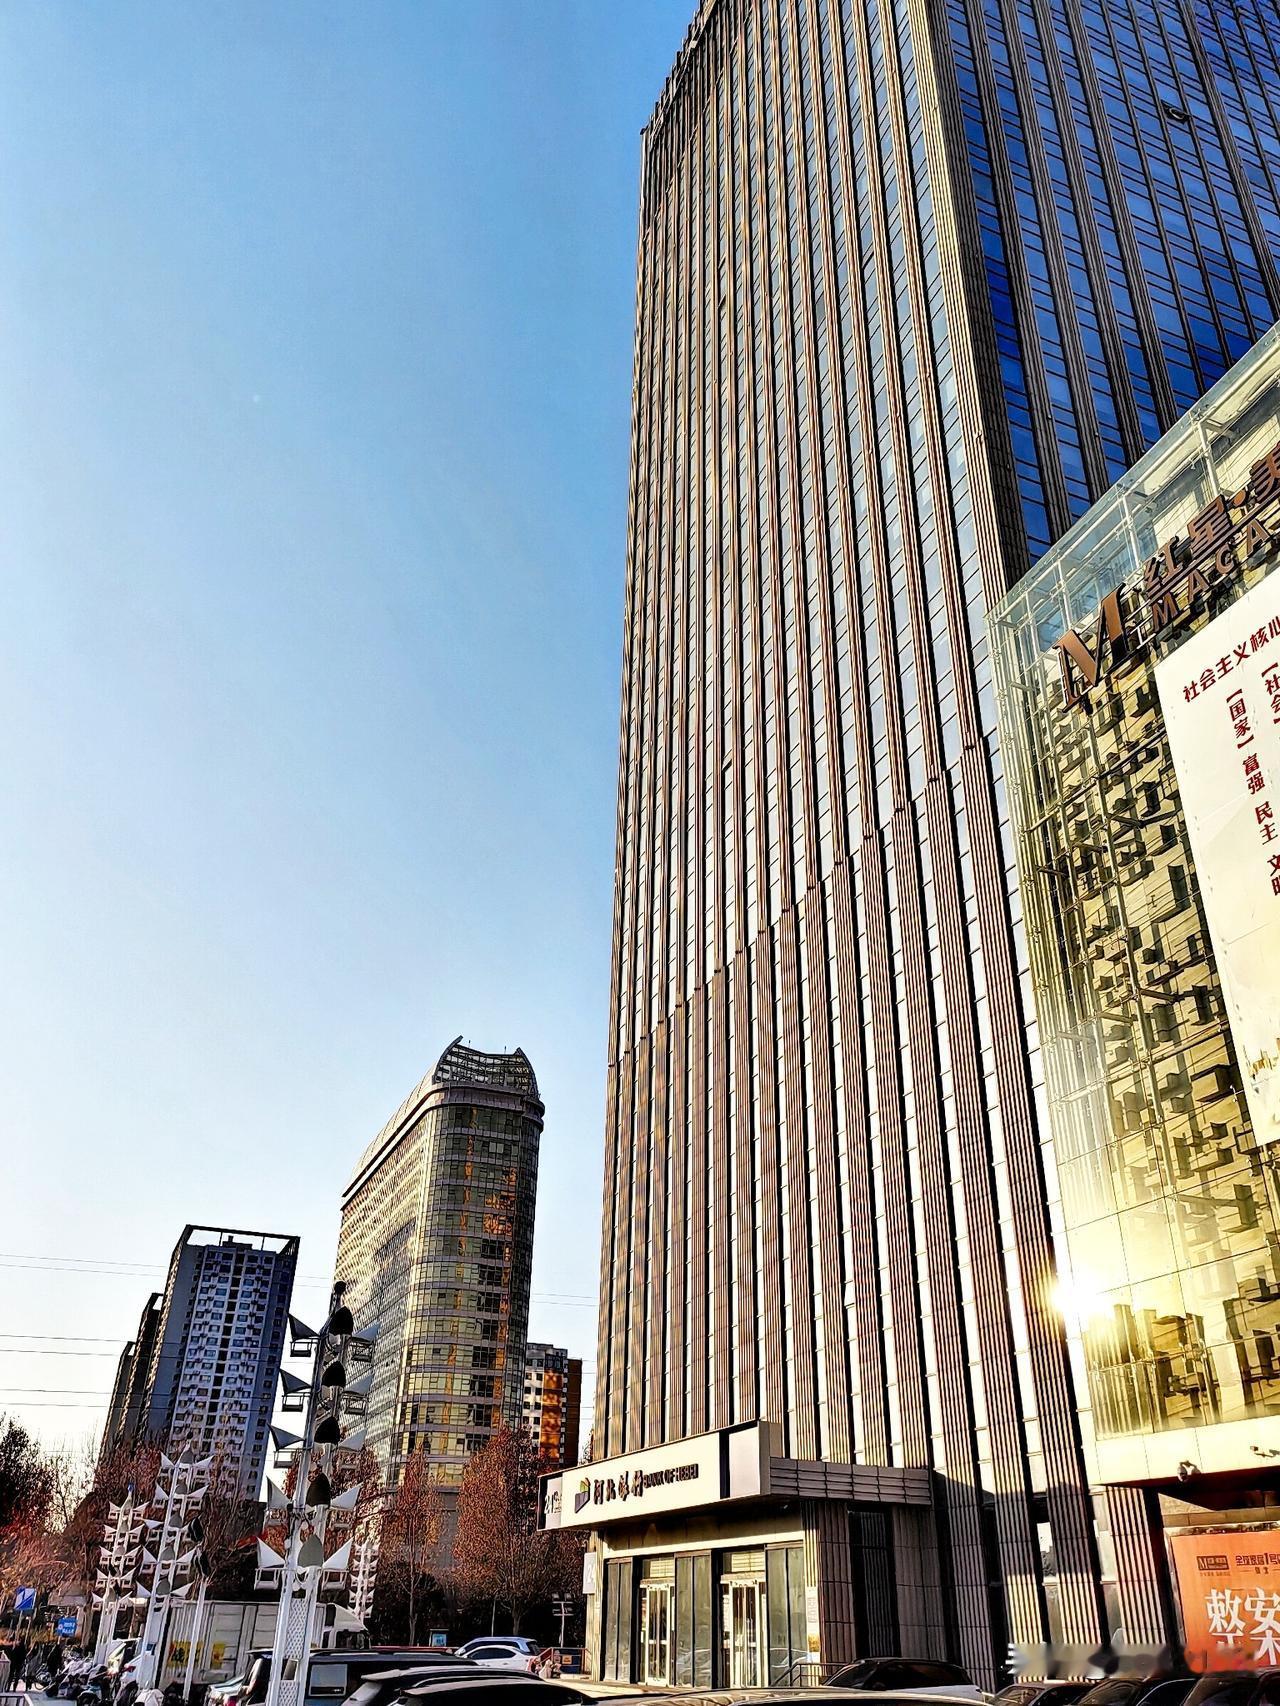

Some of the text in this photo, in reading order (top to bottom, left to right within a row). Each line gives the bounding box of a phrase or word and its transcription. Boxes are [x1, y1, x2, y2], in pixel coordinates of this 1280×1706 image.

[1242, 753, 1266, 795] 富强
[1254, 801, 1279, 846] 民主
[675, 1463, 699, 1482] HEBEI
